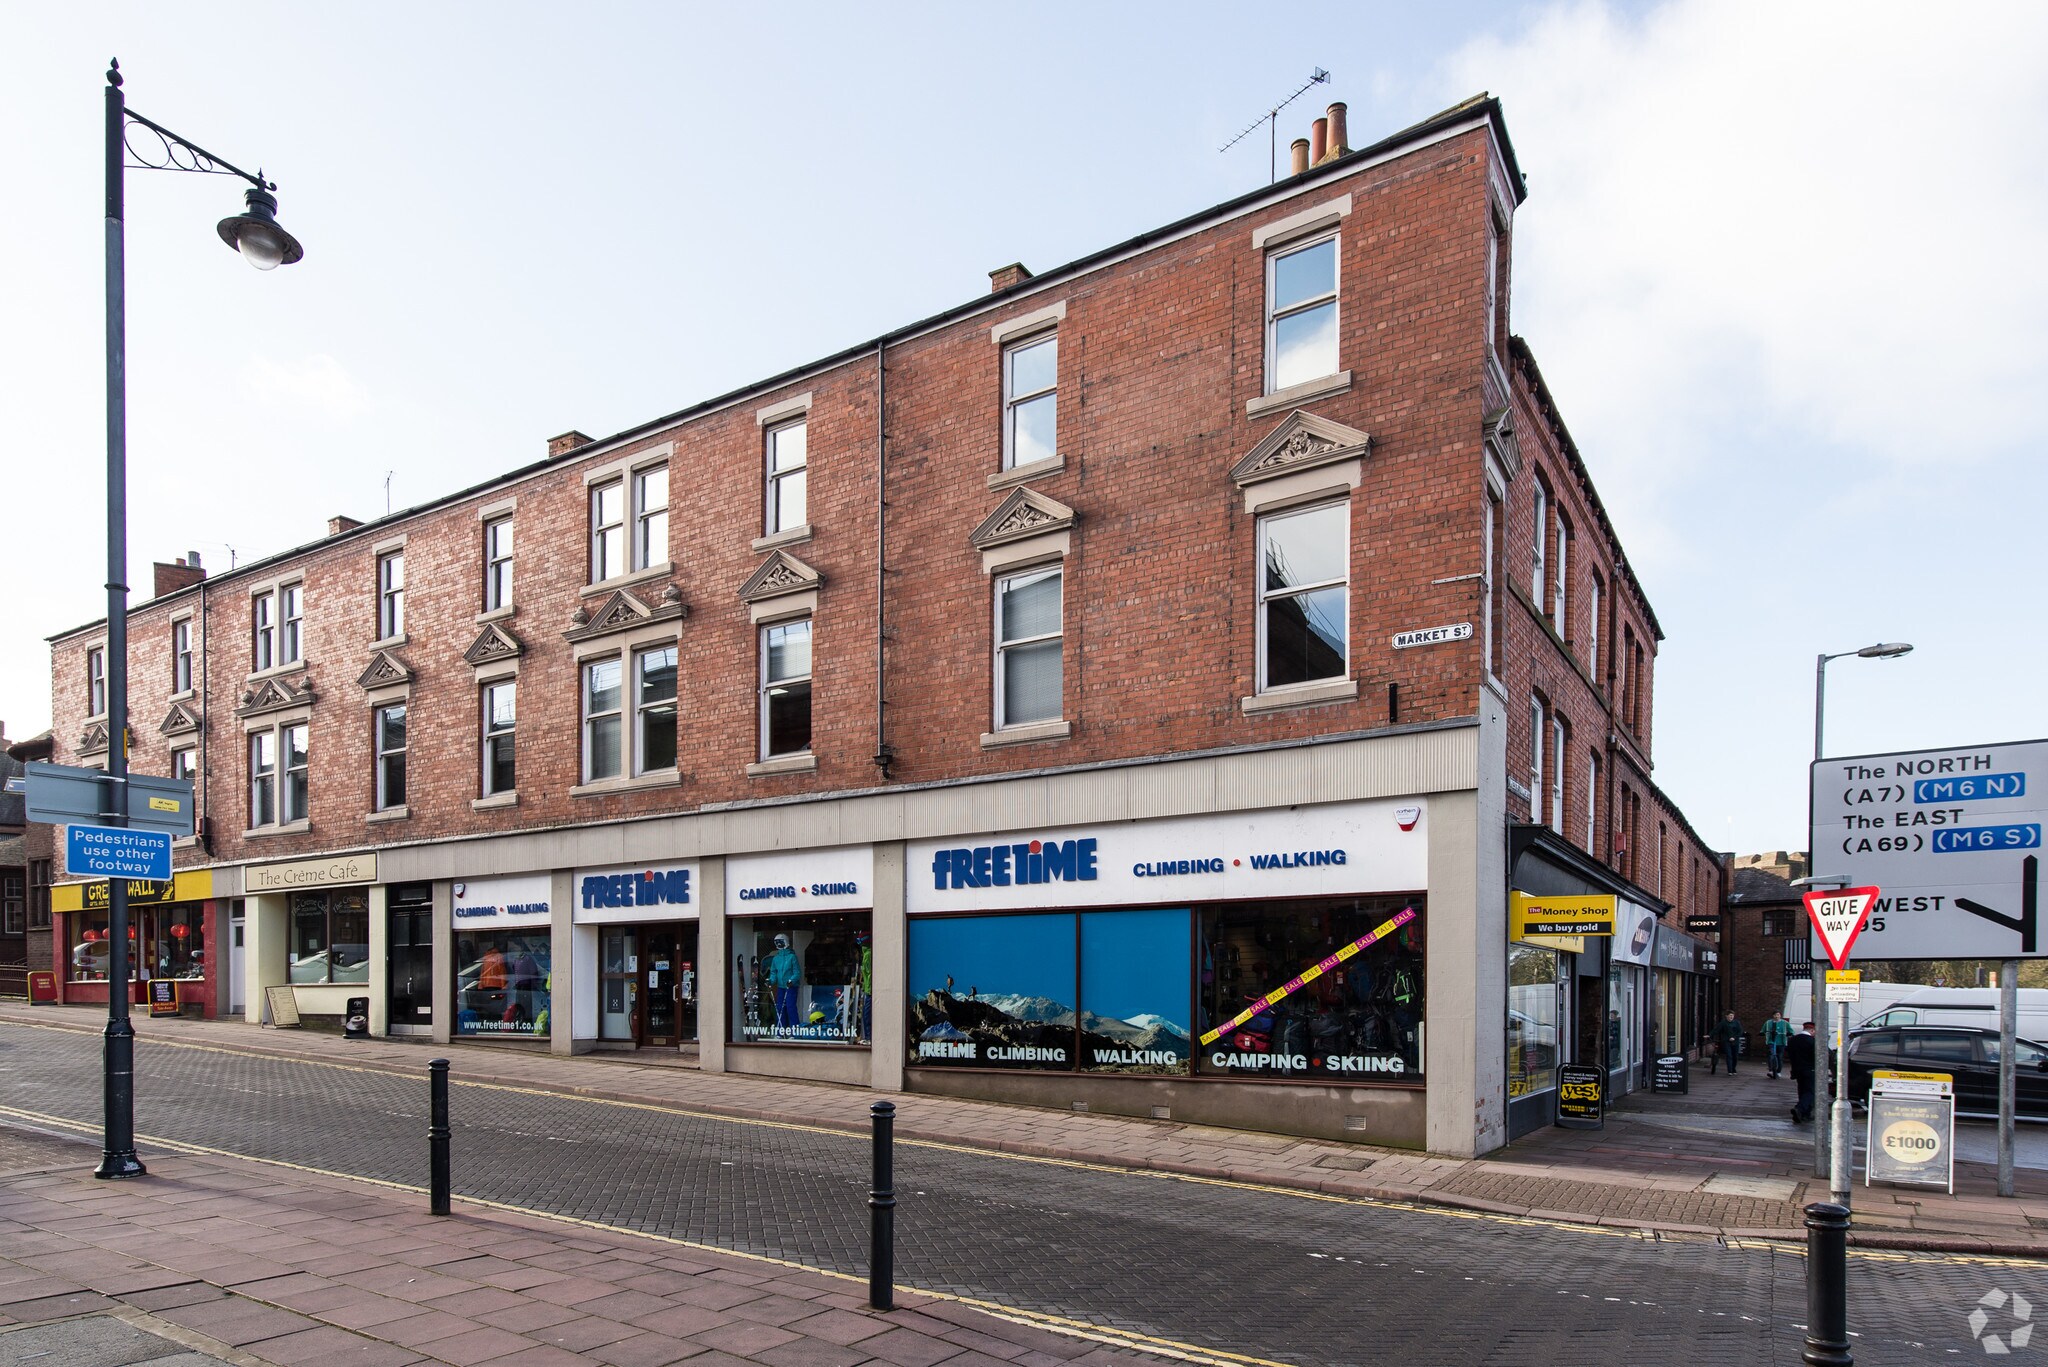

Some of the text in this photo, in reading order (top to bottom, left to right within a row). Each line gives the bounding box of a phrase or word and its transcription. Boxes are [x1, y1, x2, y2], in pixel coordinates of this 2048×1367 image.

[1398, 629, 1448, 645] MARKET
[1843, 754, 1991, 780] The NORTH
[1843, 785, 1905, 806] (A7)
[1843, 808, 1964, 829] The EAST
[75, 830, 164, 848] Pedestrians
[1843, 834, 1924, 855] (A69)
[83, 847, 156, 860] use other
[89, 858, 151, 874] footway
[1133, 849, 1346, 877] CLIMBING WALKING
[258, 869, 280, 885] The
[88, 880, 155, 900] GRE WALL
[740, 881, 857, 900] CAMPING SKIING
[455, 902, 549, 917] CLIMBING WALKING
[1542, 908, 1578, 916] Money
[1581, 907, 1609, 916] Shop
[1820, 899, 1858, 916] GIVE
[1872, 896, 1945, 912] WEST
[1538, 923, 1598, 933] We buy gold
[1826, 920, 1850, 931] WAY
[1201, 1031, 1218, 1043] SALE
[1219, 1022, 1235, 1034] SALE
[1251, 1000, 1268, 1014] SALE
[1268, 989, 1285, 1002] SALE
[1285, 978, 1302, 992] SALE
[1302, 967, 1320, 981] SALE
[1320, 956, 1338, 969] SALE
[1338, 945, 1356, 958] SALE
[1357, 934, 1376, 948] SALE
[1376, 922, 1394, 936] SALE
[1394, 910, 1413, 925] SALE
[463, 1019, 543, 1031] www.freetime1.co.uk
[742, 1024, 858, 1037] www.freetime1.co.uk
[987, 1046, 1066, 1061] CLIMBING
[1093, 1049, 1177, 1065] WALKING
[1212, 1052, 1307, 1070] CAMPING
[1326, 1055, 1404, 1073] SKIING
[1563, 1084, 1599, 1099] yes!
[1886, 1136, 1936, 1150] £1000
